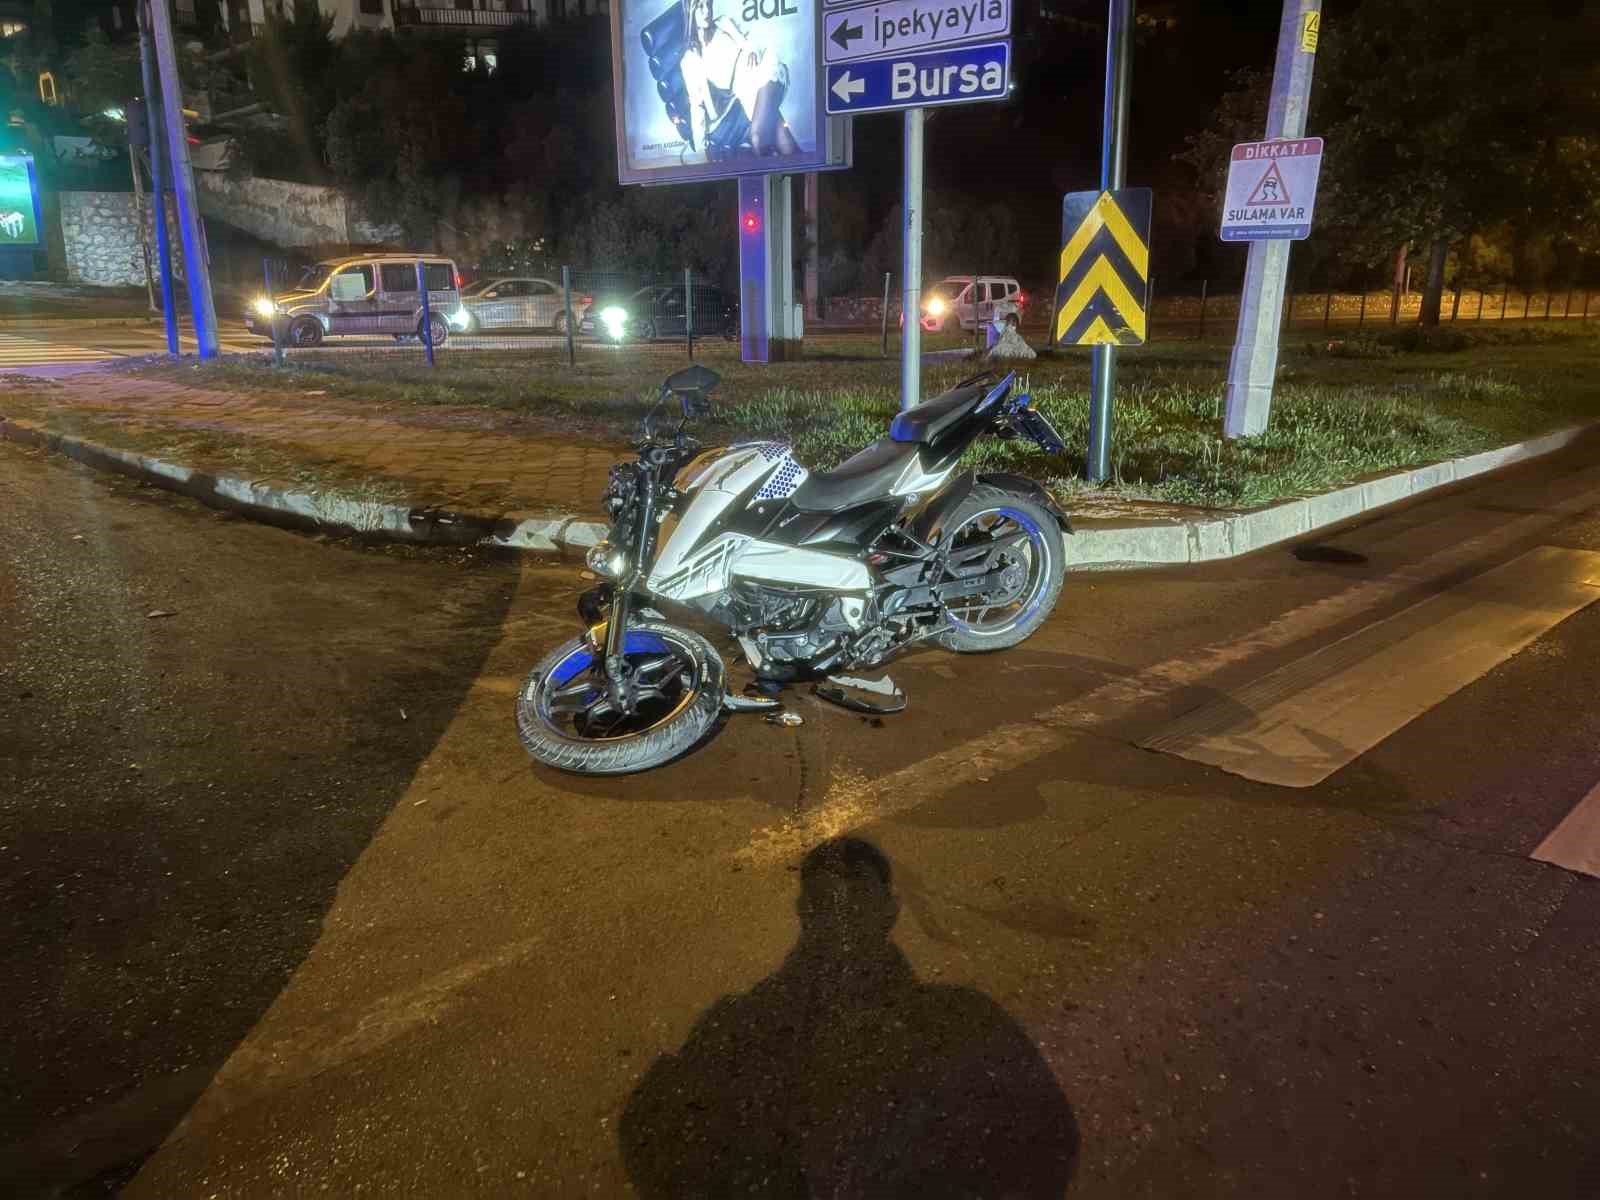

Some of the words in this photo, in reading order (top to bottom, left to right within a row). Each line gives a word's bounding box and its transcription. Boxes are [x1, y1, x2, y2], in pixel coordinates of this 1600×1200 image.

[891, 61, 1002, 100] Bursa
[1246, 143, 1299, 159] DİKKAT
[1227, 207, 1277, 221] SULAMA
[1280, 207, 1305, 220] VAR
